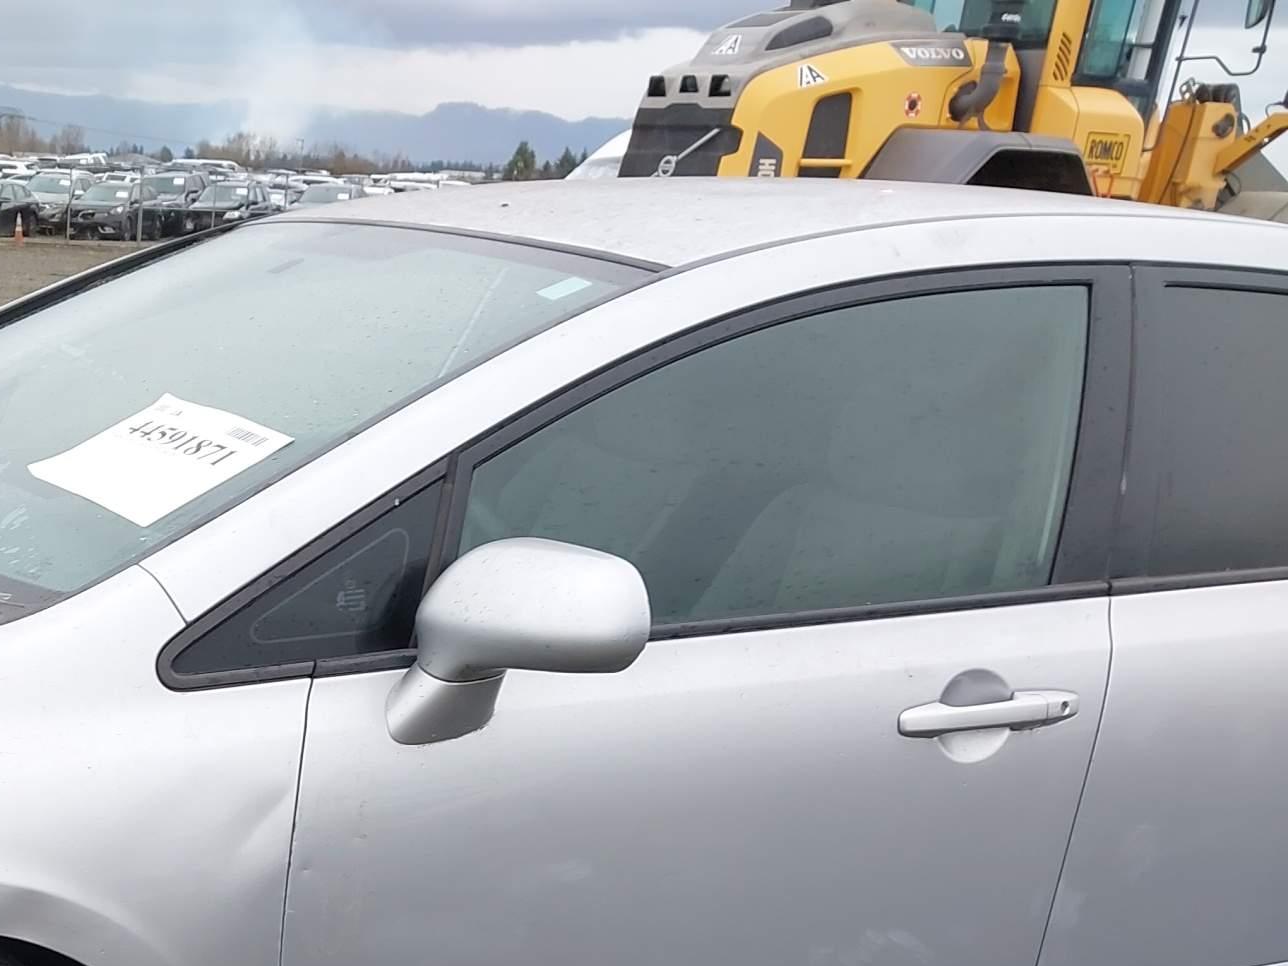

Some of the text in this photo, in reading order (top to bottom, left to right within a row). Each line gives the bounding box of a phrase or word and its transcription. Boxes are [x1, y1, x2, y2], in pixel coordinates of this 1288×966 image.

[900, 47, 965, 60] VOLVO
[1088, 139, 1124, 160] ROMCO
[129, 421, 237, 466] 44591871
